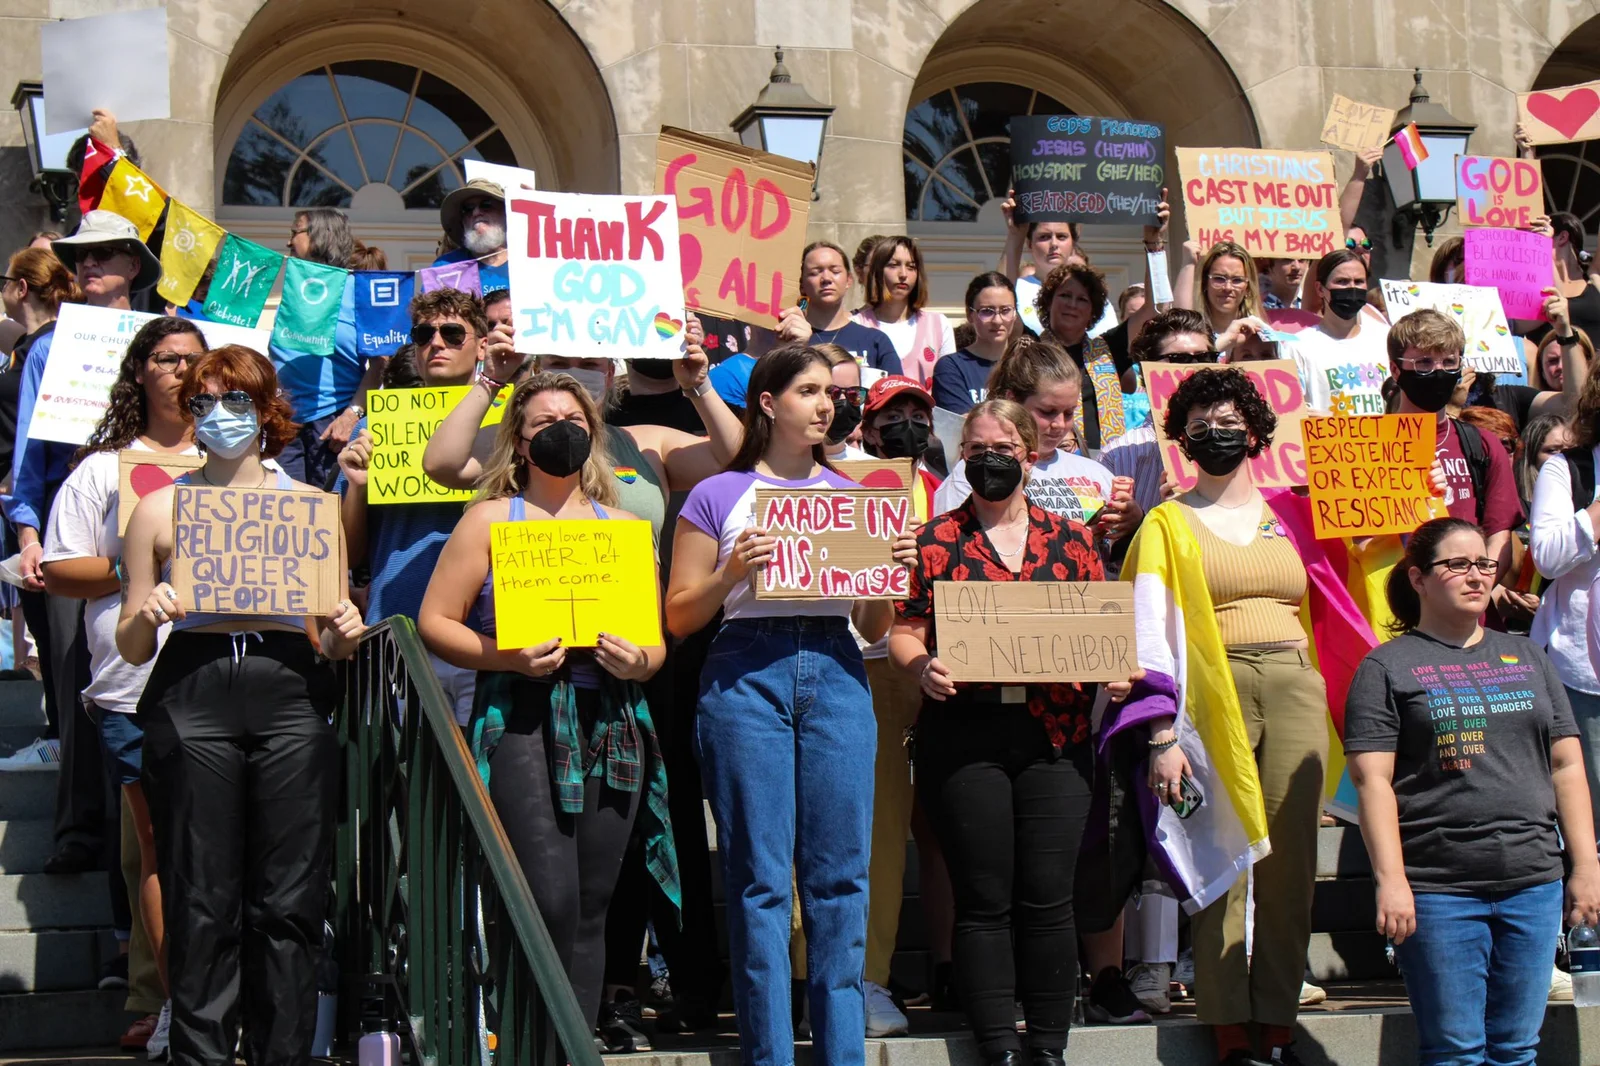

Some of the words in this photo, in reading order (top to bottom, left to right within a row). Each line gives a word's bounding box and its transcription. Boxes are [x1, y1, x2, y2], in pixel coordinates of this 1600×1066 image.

[1334, 97, 1386, 124] LOVE
[1032, 139, 1086, 157] JESUS
[1094, 140, 1156, 163] (HE/HIM)
[1096, 160, 1164, 188] (SHE/HER)
[1199, 153, 1324, 183] CHRISTIANS
[1461, 157, 1539, 197] GOD
[664, 153, 791, 240] GOD
[1019, 190, 1077, 213] REATOR
[1106, 192, 1160, 216] (THEY/THE
[1186, 178, 1248, 206] CAST
[1253, 181, 1291, 208] ME
[1295, 183, 1335, 208] OUT
[1493, 194, 1504, 206] IS
[1217, 207, 1254, 225] BUT
[1259, 207, 1328, 231] JESUS
[1468, 198, 1531, 227] LOVE
[1199, 228, 1235, 249] HAS
[1244, 229, 1279, 252] MY
[1284, 231, 1335, 256] BACK
[1473, 244, 1549, 267] BLACKLISTED
[553, 260, 646, 307] GOD
[1466, 267, 1488, 280] FOR
[1491, 268, 1521, 283] HAVING
[1525, 272, 1537, 283] AN
[718, 257, 786, 319] ALL
[1498, 289, 1534, 308] NION
[207, 301, 252, 328] Celebrate!
[520, 302, 576, 342] I'M
[587, 304, 660, 346] GAY
[74, 332, 97, 342] OUR
[101, 335, 132, 346] CHUR
[280, 326, 331, 350] Community
[363, 331, 408, 352] Equality
[95, 366, 121, 376] BLAC
[1462, 356, 1520, 371] TUMN!
[371, 394, 399, 413] DO
[410, 391, 449, 410] NOT
[371, 419, 443, 448] SILEN
[1304, 416, 1384, 442] RESPECT
[1395, 417, 1424, 440] MY
[373, 450, 411, 470] OUR
[1309, 441, 1414, 465] EXISTENCE
[1313, 469, 1346, 490] OR
[1351, 466, 1428, 490] EXPECT
[177, 487, 323, 526] RESPECT
[763, 494, 857, 534] MADE
[865, 497, 908, 540] IN
[176, 520, 332, 561] RELIGIOUS
[497, 527, 512, 547] If
[517, 527, 552, 554] they
[559, 526, 589, 543] love
[593, 531, 613, 554] my
[496, 547, 588, 569] FATHER.
[593, 546, 620, 564] let
[763, 535, 814, 592] HIS
[819, 547, 909, 597] image
[192, 555, 308, 587] QUEER
[500, 576, 551, 592] them
[558, 572, 619, 585] come.
[192, 583, 308, 613] PEOPLE
[942, 584, 1009, 625] LOVE
[1037, 583, 1089, 615] THY
[989, 634, 1132, 677] NEIGHBOR
[1412, 666, 1435, 676] LOVE
[1439, 665, 1463, 673] OVER
[1466, 661, 1490, 670] HATE
[1417, 674, 1440, 684] LOVE
[1444, 672, 1468, 680] OVER
[1472, 664, 1536, 679] INDIFFERENCE
[1426, 688, 1449, 697] LOVE
[1454, 687, 1477, 695] OVER
[1482, 685, 1500, 693] EGO
[1448, 680, 1472, 688] OVER
[1478, 674, 1528, 686] IGNORANCE
[1428, 696, 1453, 708] LOVE
[1458, 695, 1482, 704] OVER
[1486, 690, 1535, 702] BARRIERS
[1431, 706, 1456, 720] LOVE
[1461, 705, 1486, 715] OVER
[1491, 700, 1533, 714] BORDERS
[1434, 720, 1458, 733] LOVE
[1463, 718, 1487, 729] OVER
[1437, 733, 1455, 746] AND
[1461, 731, 1484, 742] OVER
[1439, 747, 1457, 759] AND
[1463, 744, 1486, 755] OVER
[1442, 758, 1471, 770] AGAIN
